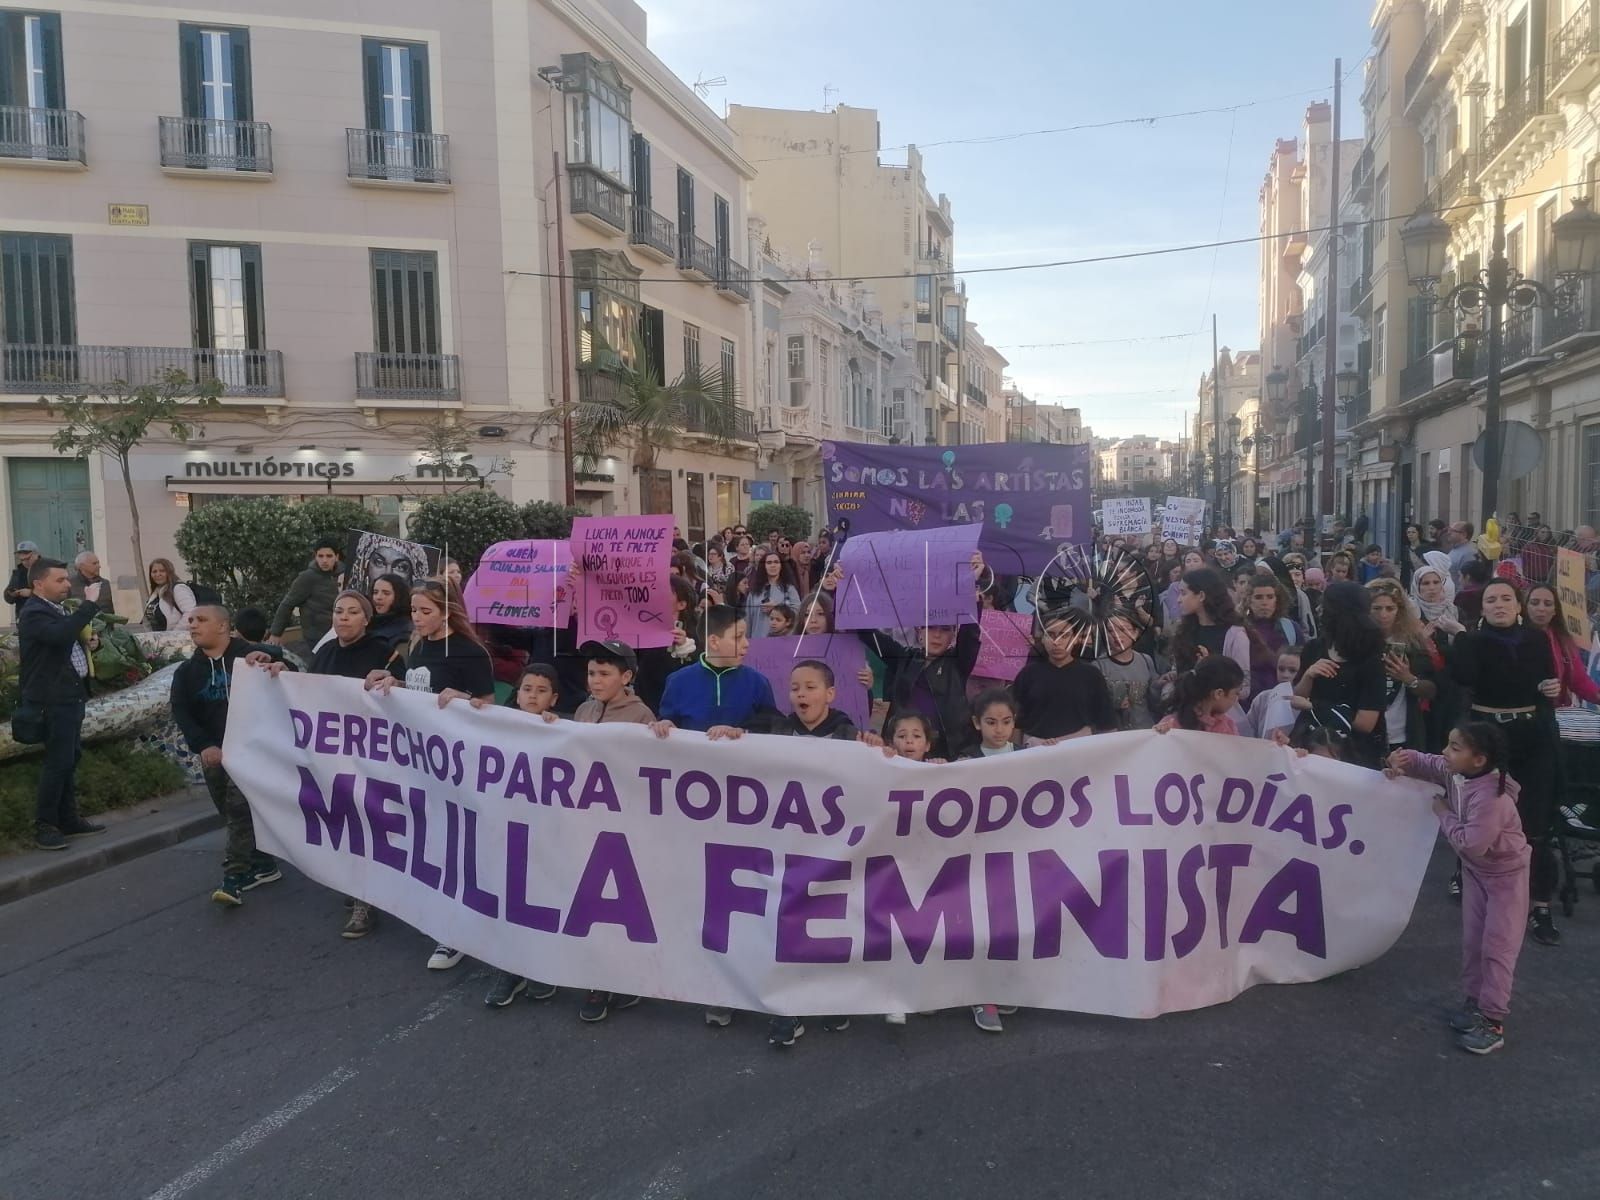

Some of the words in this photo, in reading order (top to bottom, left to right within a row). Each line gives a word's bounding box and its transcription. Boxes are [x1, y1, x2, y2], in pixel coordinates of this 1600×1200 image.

[831, 462, 909, 488] SOMOS
[918, 470, 965, 490] LAS
[976, 468, 1084, 491] ARTISTAS
[941, 500, 985, 521] LAS
[585, 527, 618, 540] LUCHA
[624, 527, 667, 540] AUNQUE
[590, 542, 604, 554] NO
[610, 542, 623, 552] TE
[627, 542, 659, 553] FALTE
[582, 554, 608, 572] NADA
[646, 556, 654, 567] A
[596, 572, 636, 585] ALGUNAS
[639, 571, 657, 583] LES
[624, 586, 650, 603] TODO
[488, 601, 541, 618] FLOWERS
[289, 708, 466, 787] DERECHOS
[477, 745, 621, 812] PARA
[638, 766, 866, 847] TODAS,
[888, 775, 1093, 838] TODOS
[1114, 772, 1206, 826] LOS
[1216, 772, 1365, 856] DÍAS.
[297, 765, 658, 944] MELILLA
[702, 843, 1327, 965] FEMINISTA
